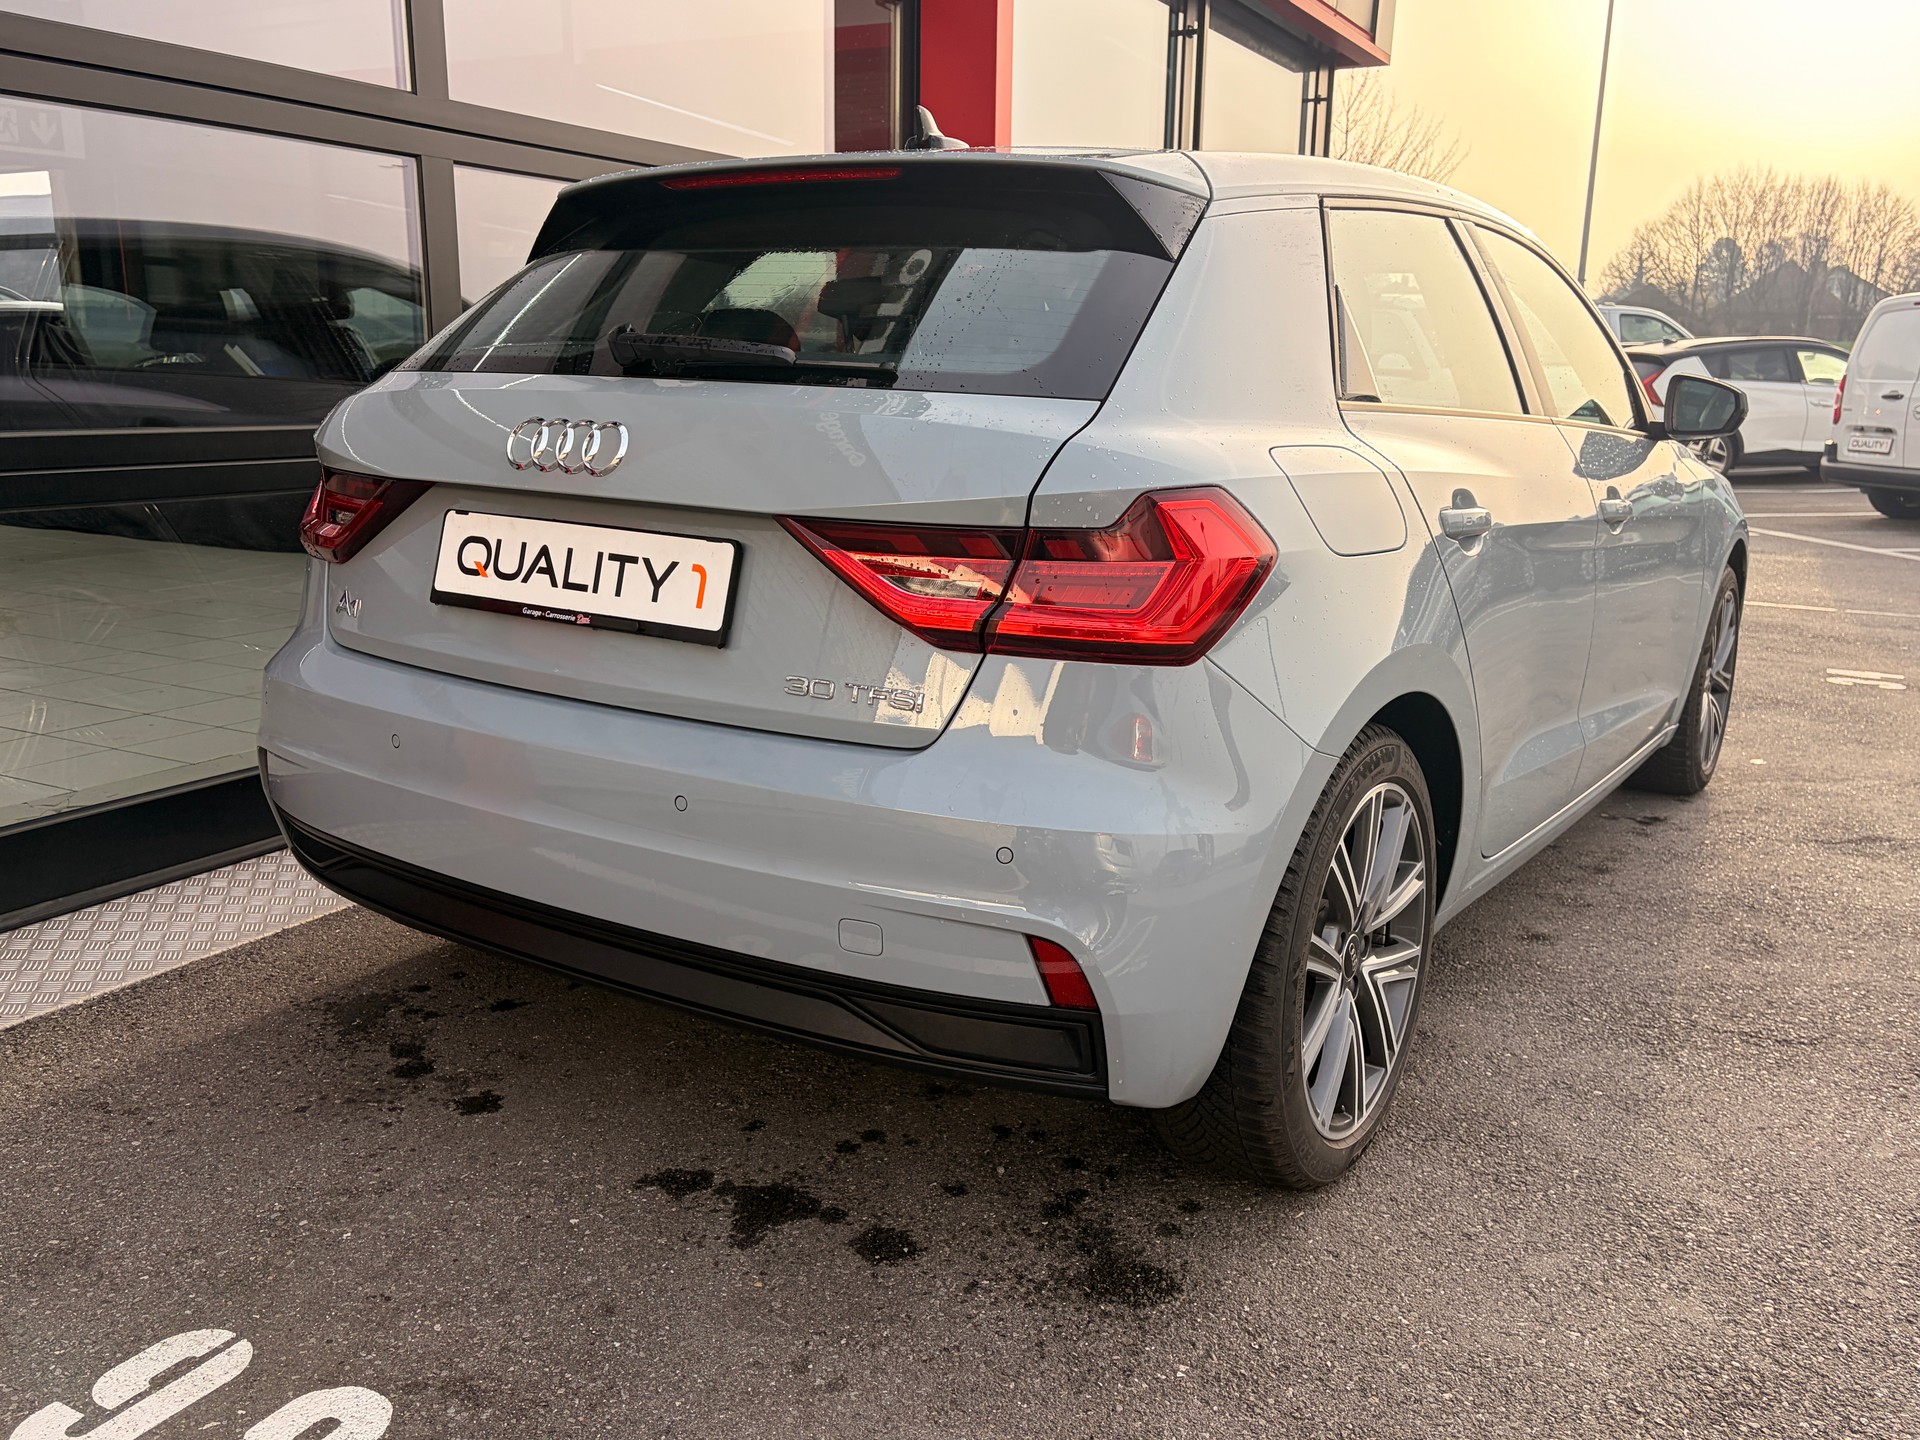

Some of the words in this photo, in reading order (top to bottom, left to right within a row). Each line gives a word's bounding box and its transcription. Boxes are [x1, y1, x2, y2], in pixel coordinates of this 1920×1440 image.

[456, 535, 680, 603] QUALITY
[691, 563, 707, 609] 1
[522, 606, 542, 618] Garage
[545, 610, 576, 622] Carrosserie
[783, 674, 836, 701] 30
[845, 682, 926, 714] TFSI
